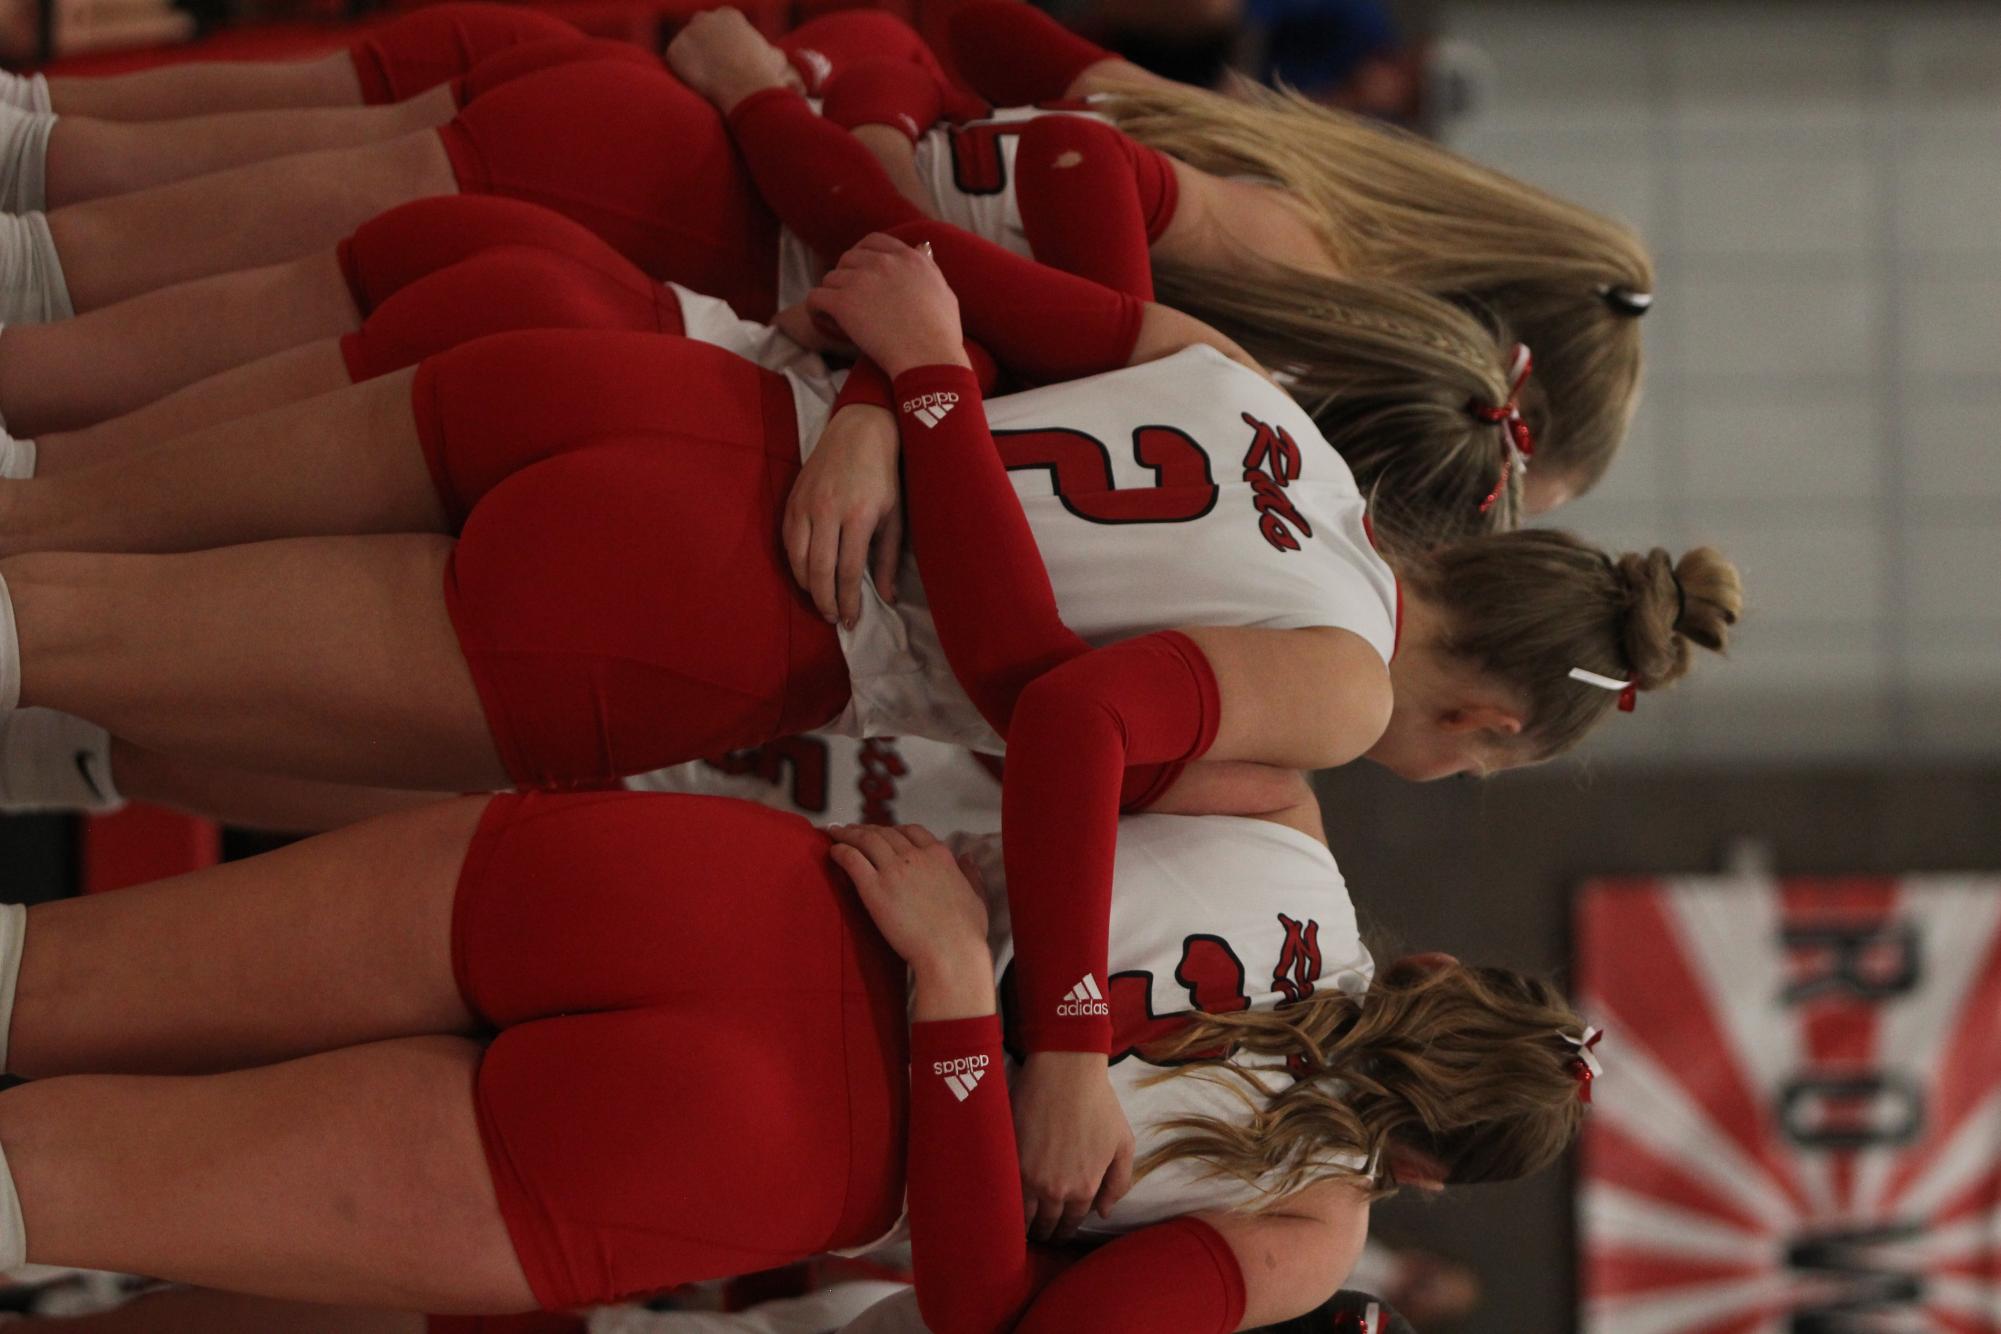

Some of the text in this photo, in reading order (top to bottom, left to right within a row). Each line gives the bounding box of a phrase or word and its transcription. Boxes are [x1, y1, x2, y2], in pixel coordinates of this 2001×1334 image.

[903, 391, 960, 413] adidas
[990, 425, 1220, 526] 2
[1056, 999, 1109, 1016] adidas
[933, 1054, 990, 1075] adidas
